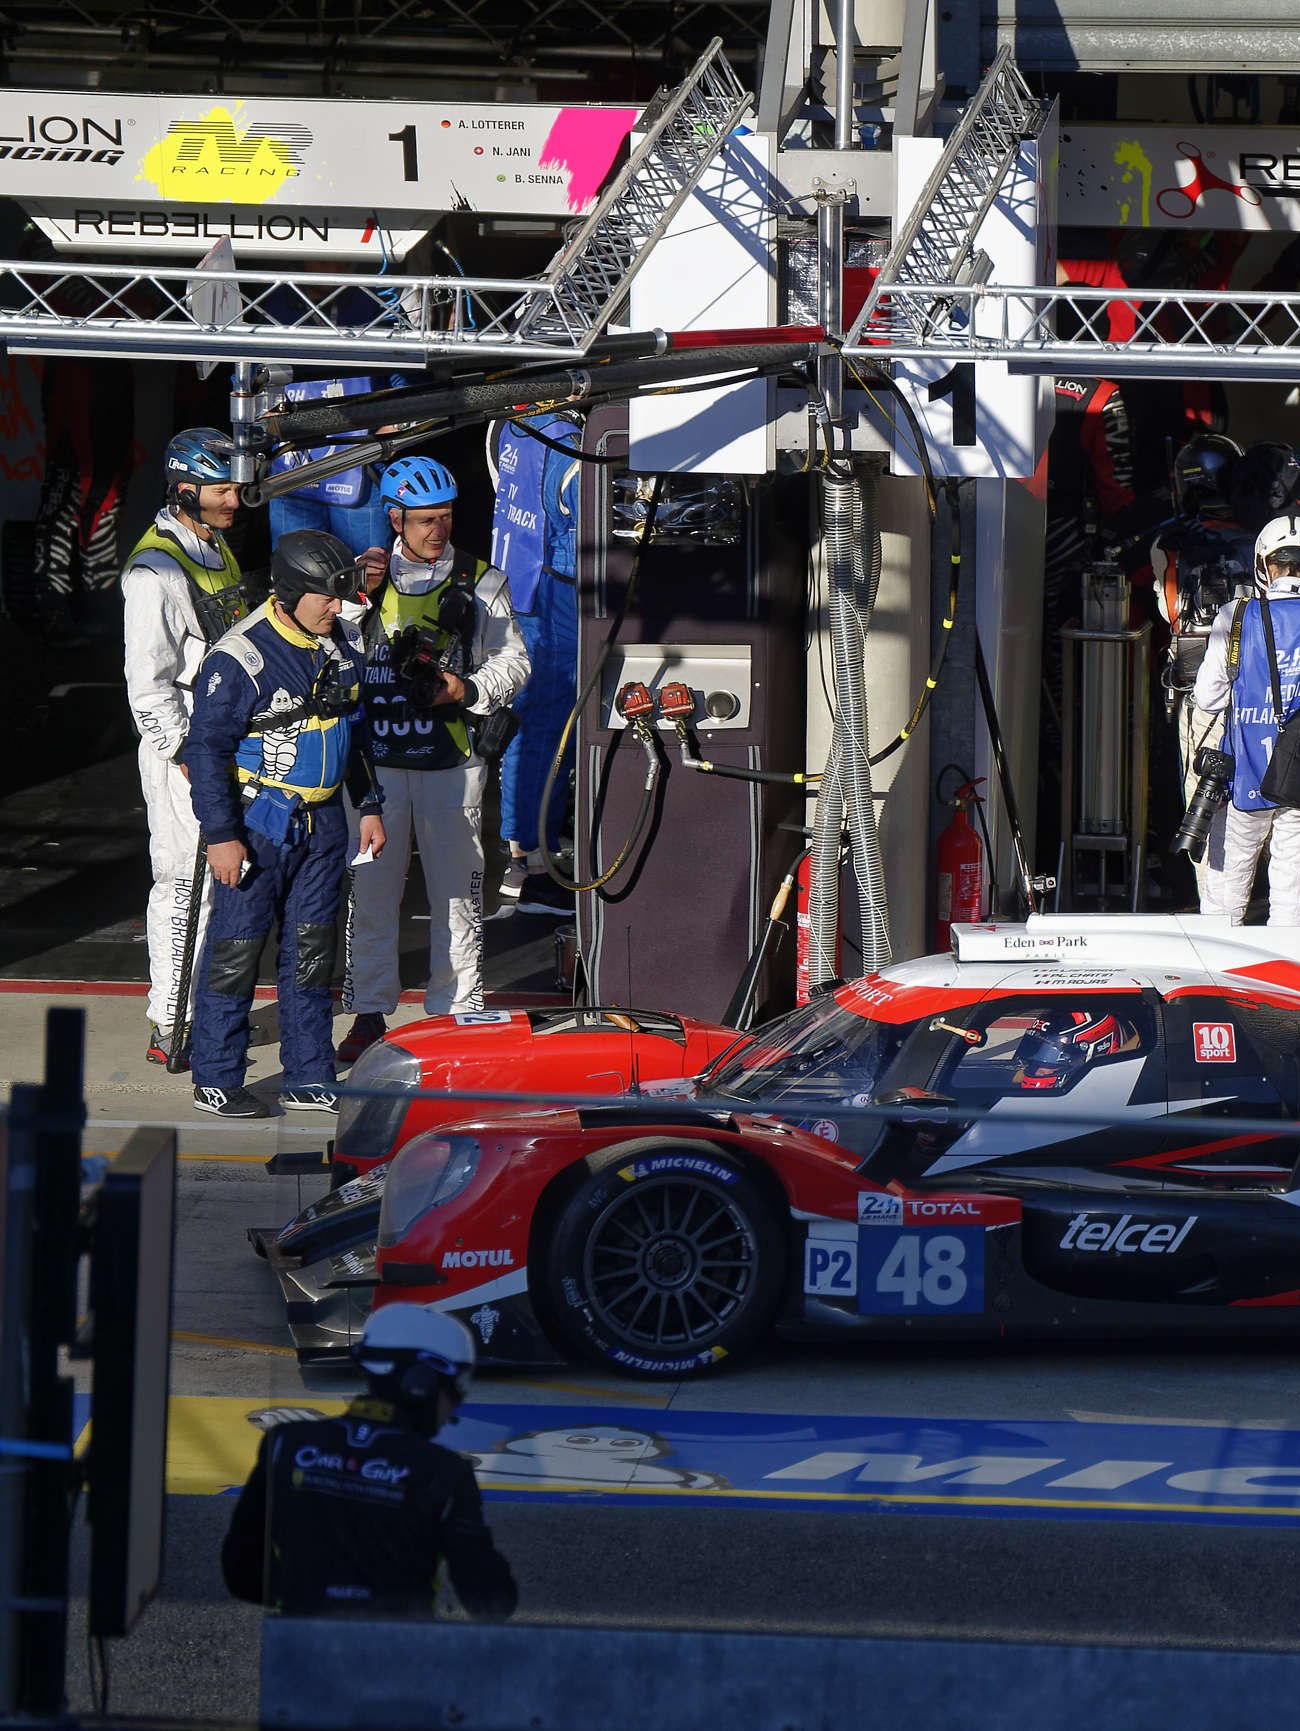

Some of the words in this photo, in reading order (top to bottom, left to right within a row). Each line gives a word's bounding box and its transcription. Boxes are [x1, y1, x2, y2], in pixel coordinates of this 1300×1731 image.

[458, 120, 469, 130] A.
[472, 120, 525, 131] LOTTERER
[388, 125, 418, 182] 1
[492, 147, 504, 156] N.
[506, 147, 531, 157] JANI
[172, 165, 302, 177] RACING
[515, 174, 526, 184] B.
[528, 174, 564, 185] SENNA
[928, 361, 977, 447] 1
[507, 503, 537, 529] TRACK
[1230, 641, 1240, 665] Nikon
[175, 878, 193, 913] HOST
[1003, 937, 1035, 948] Eden
[1057, 936, 1088, 947] Park
[1198, 1026, 1228, 1050] 10
[1200, 1048, 1231, 1059] sport
[651, 1157, 733, 1182] MICHELIN
[906, 1201, 981, 1215] TOTAL
[1059, 1213, 1199, 1253] telcel
[441, 1249, 514, 1268] MOTUL
[809, 1248, 853, 1289] P2
[876, 1235, 968, 1306] 48
[612, 1349, 698, 1373] MICHELIN
